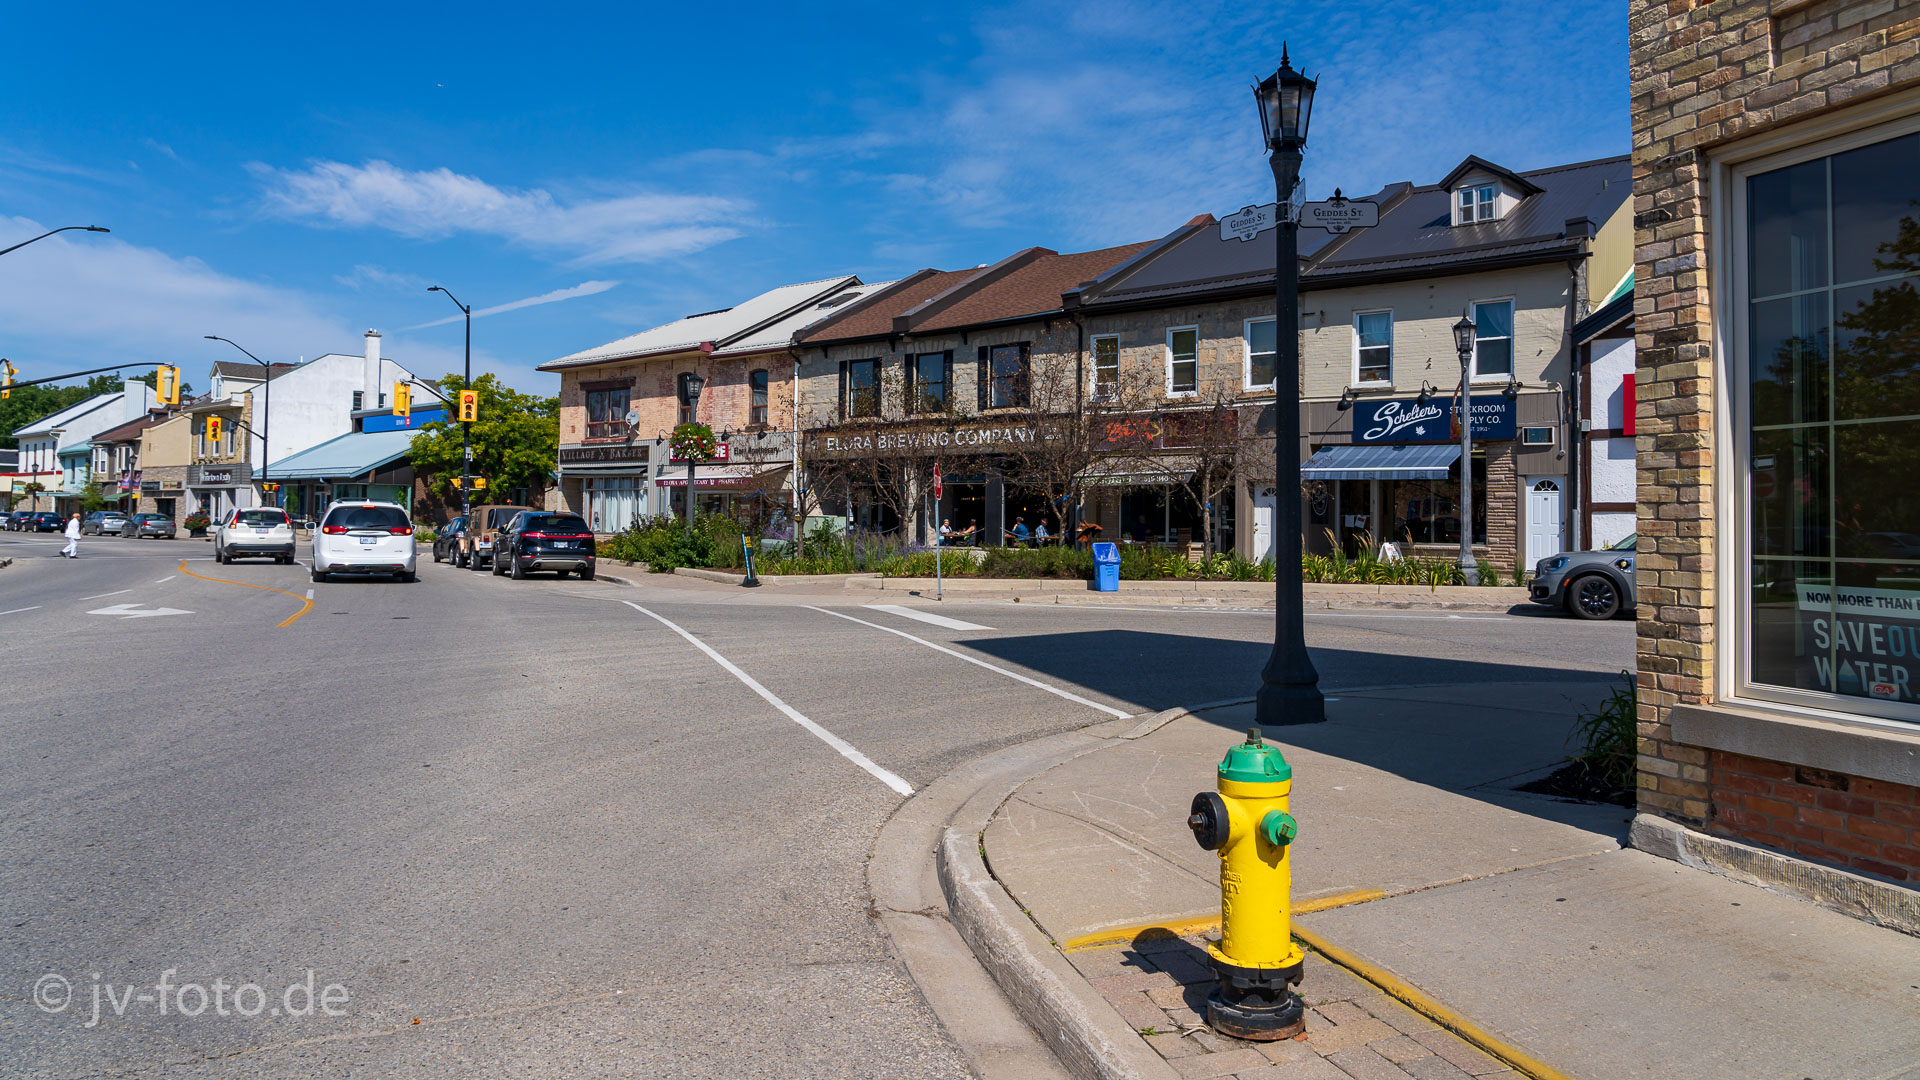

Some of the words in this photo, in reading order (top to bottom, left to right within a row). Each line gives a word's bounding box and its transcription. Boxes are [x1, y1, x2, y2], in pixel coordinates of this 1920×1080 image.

[1313, 208, 1348, 217] GEDDES
[1486, 415, 1501, 424] CO.
[826, 435, 872, 450] ELORA
[878, 431, 949, 450] BREWING
[955, 429, 1037, 445] COMPANY
[562, 450, 595, 461] VILLAGE
[1806, 592, 1832, 604] NOW
[1837, 594, 1873, 608] MORE
[1875, 597, 1912, 611] THAN
